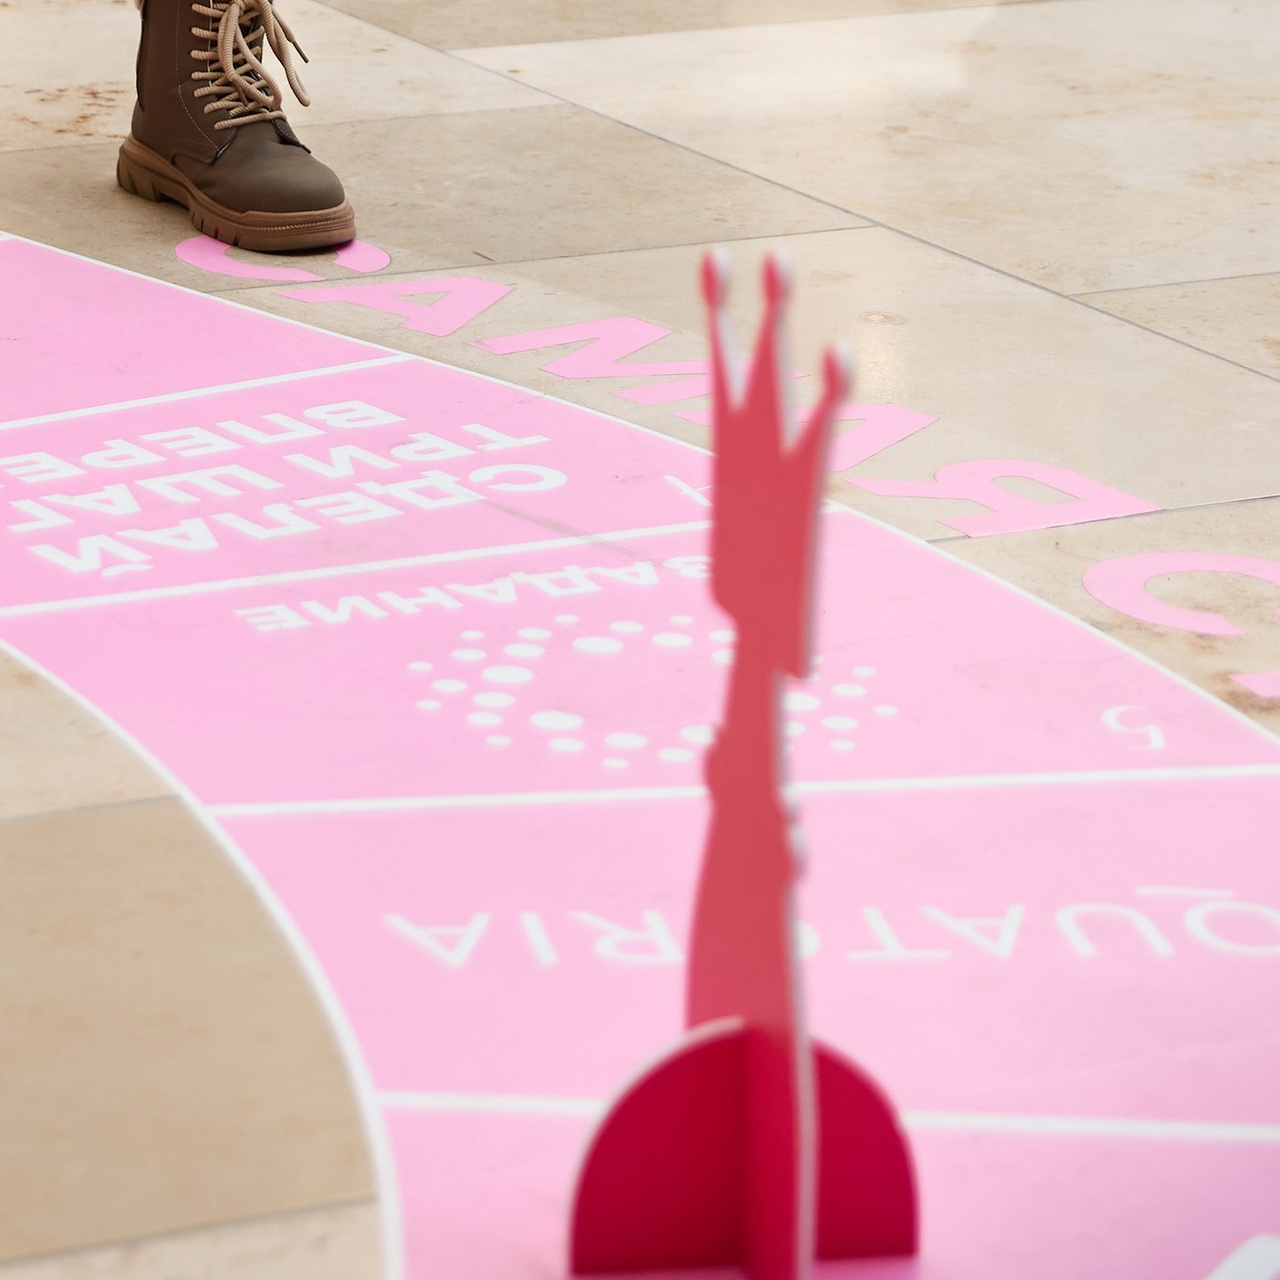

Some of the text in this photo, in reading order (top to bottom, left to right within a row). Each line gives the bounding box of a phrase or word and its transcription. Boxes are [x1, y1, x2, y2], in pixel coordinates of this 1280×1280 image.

[283, 422, 552, 480] ТРИ
[27, 462, 569, 577] СДЕЛАЙ
[232, 553, 713, 633] ЗАДАНИЕ
[1099, 704, 1166, 751] 5
[381, 886, 1280, 970] QUATRIA
